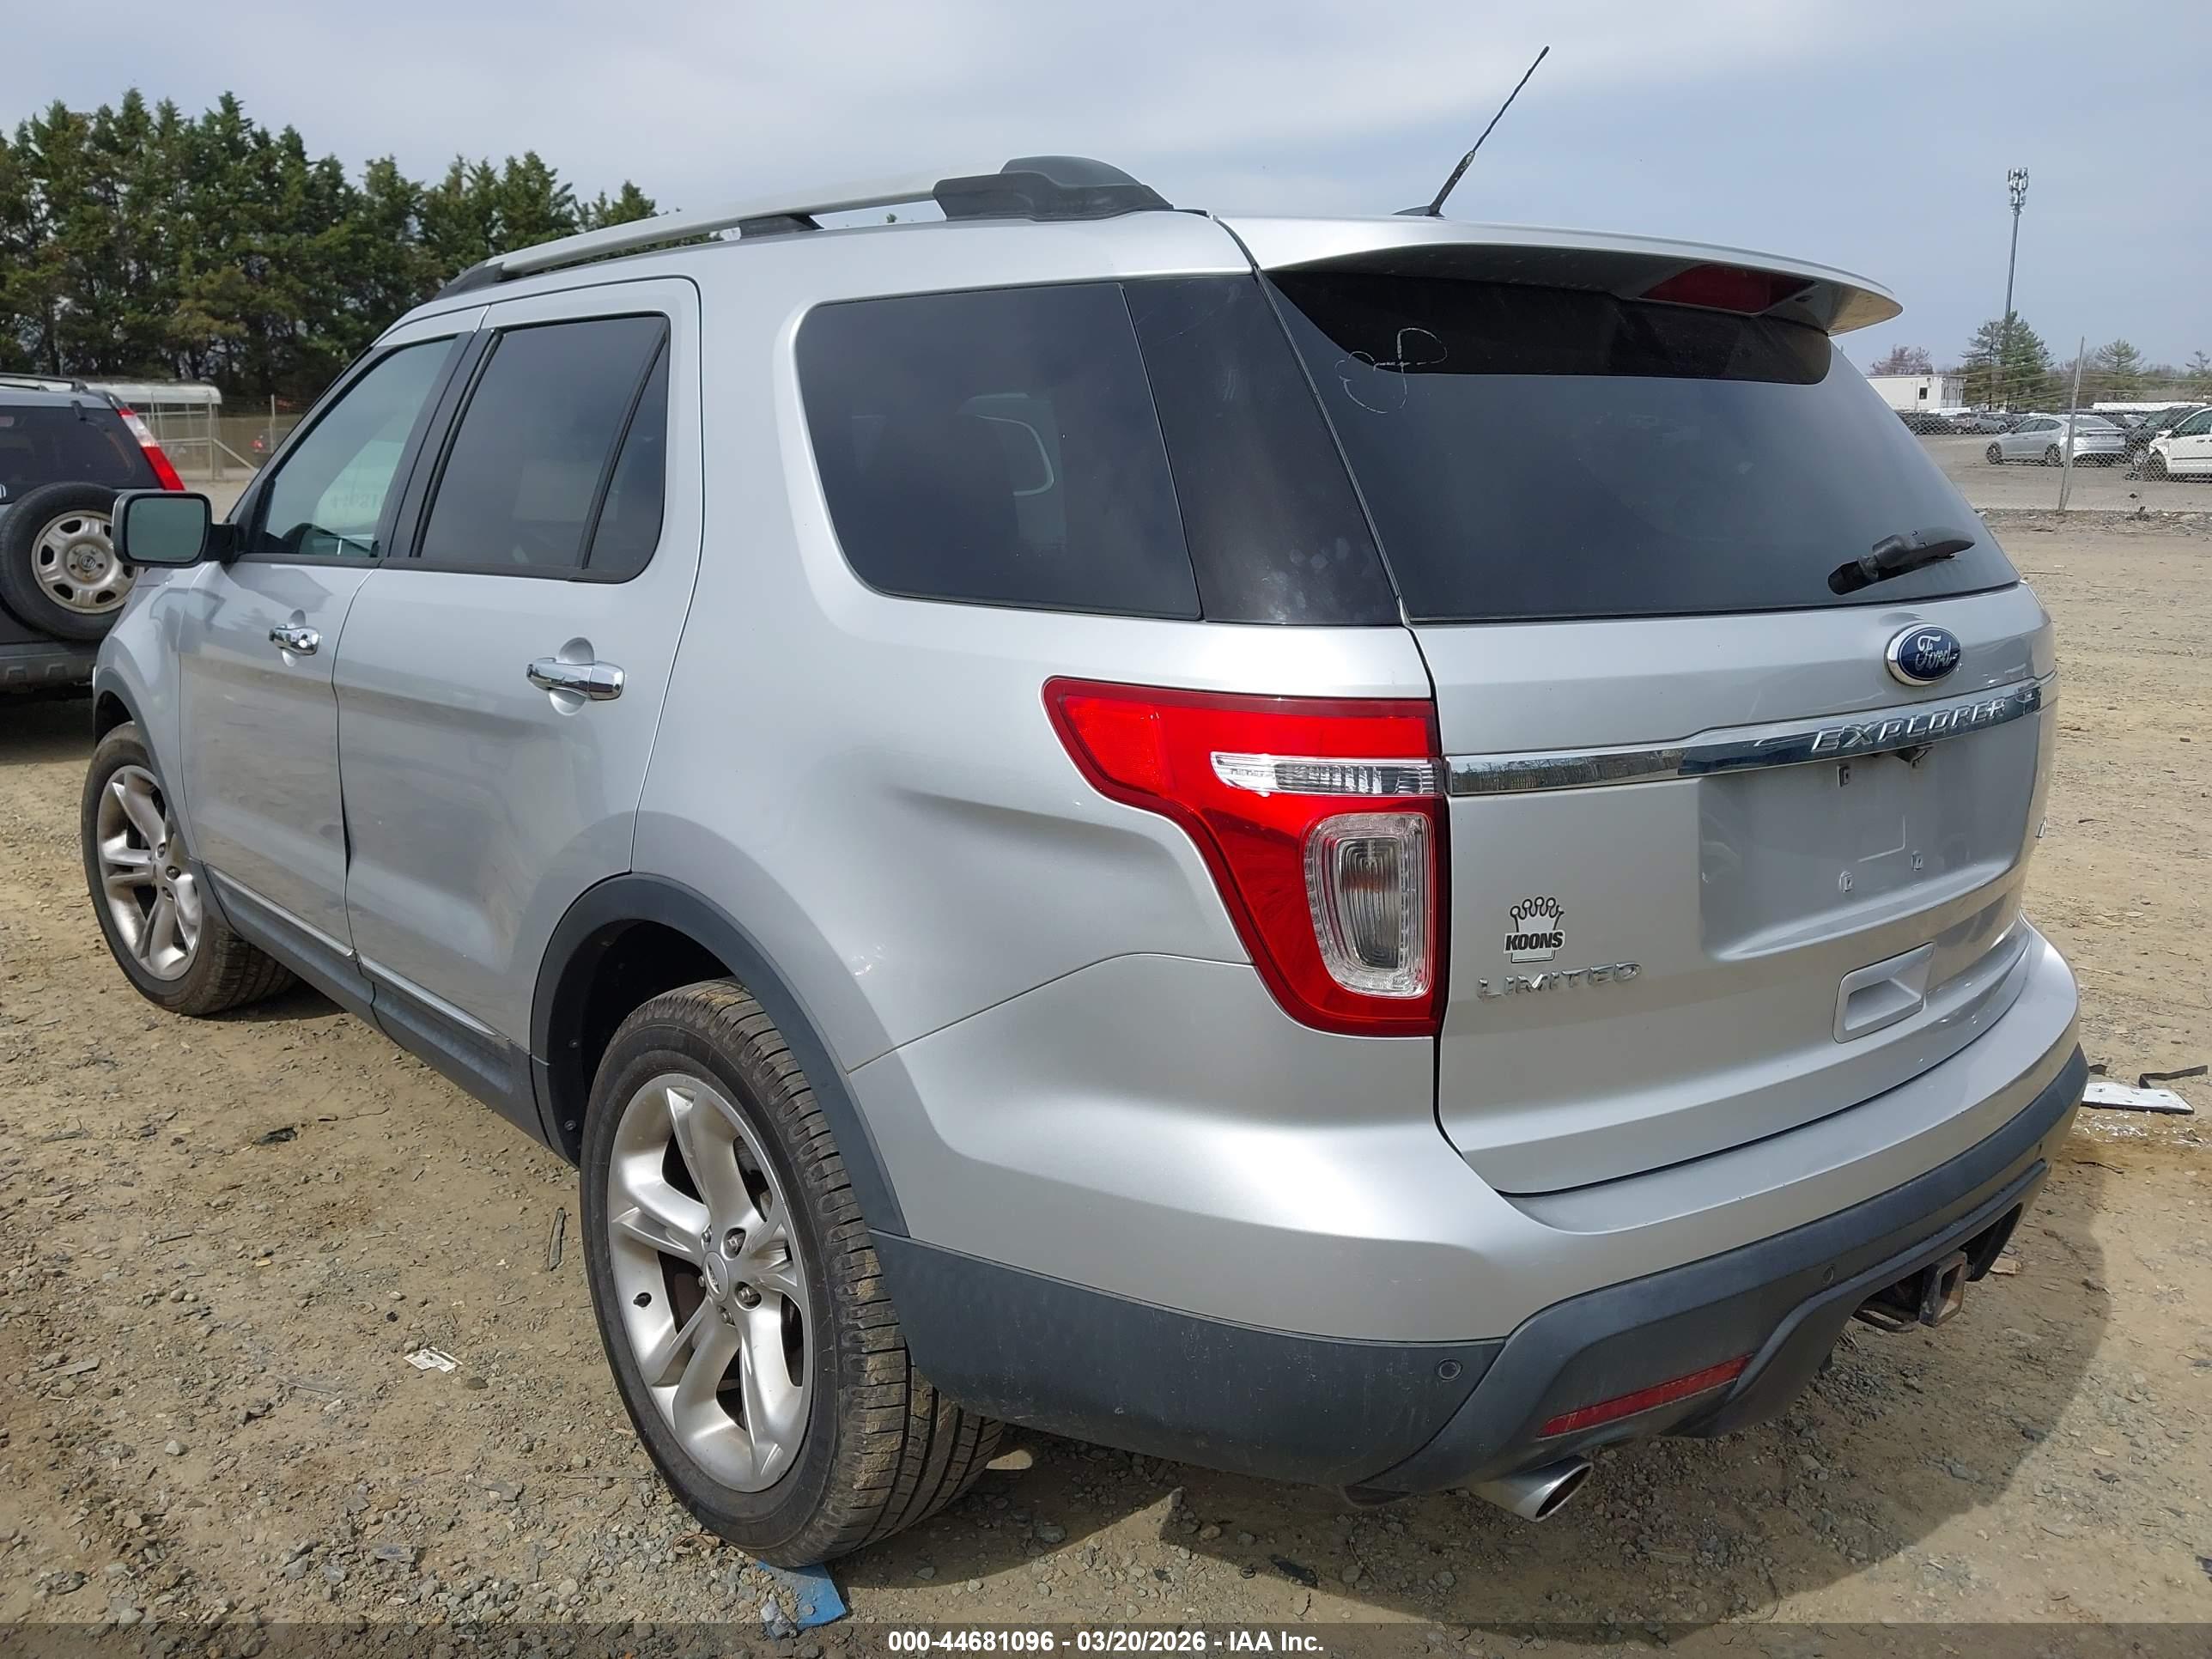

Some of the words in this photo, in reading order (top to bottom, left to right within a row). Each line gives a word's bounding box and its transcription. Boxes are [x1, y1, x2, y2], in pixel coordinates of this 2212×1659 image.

[1915, 635, 1958, 672] Ford
[1811, 696, 2006, 753] EXPLORER
[1505, 932, 1563, 951] KOONS
[1477, 962, 1642, 1001] LIMITED
